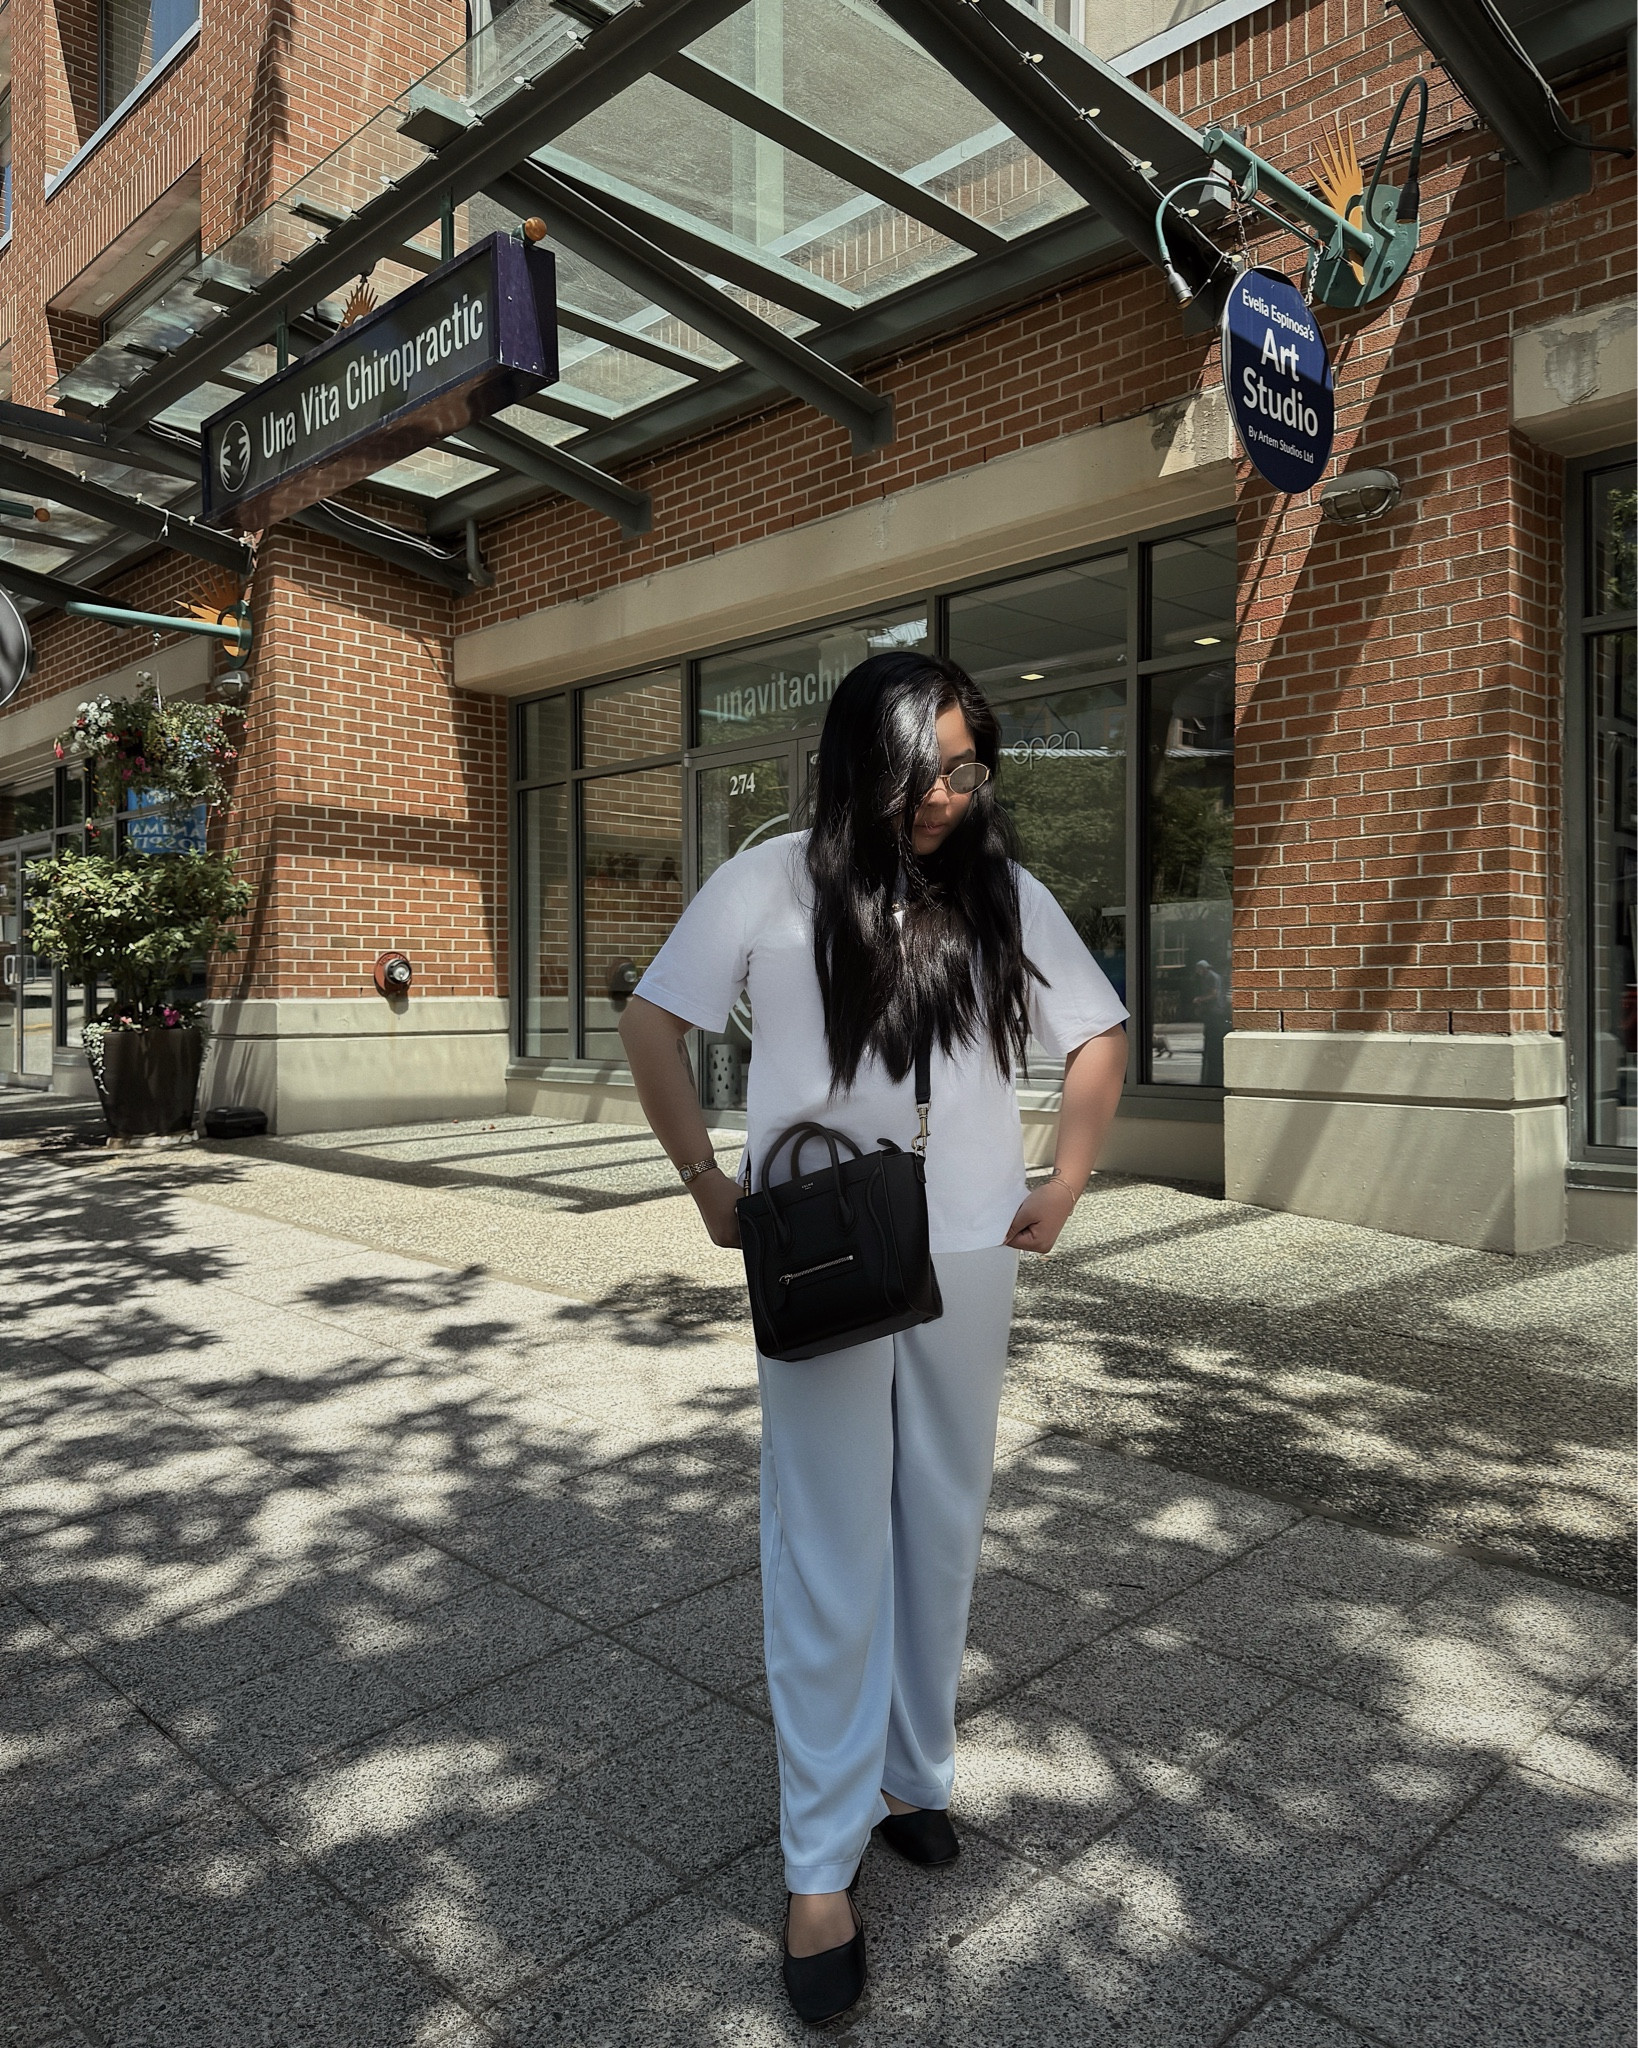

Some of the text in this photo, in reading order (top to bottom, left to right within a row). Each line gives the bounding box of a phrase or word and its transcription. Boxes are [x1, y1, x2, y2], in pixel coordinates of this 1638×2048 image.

[1242, 288, 1315, 342] Evelia Espinosa's
[262, 294, 484, 459] Una Vita Chiropractic
[1261, 327, 1300, 382] Art
[1243, 366, 1319, 437] Studio
[1248, 424, 1314, 464] By Artem Studios Ltd
[1012, 730, 1081, 770] open
[729, 772, 756, 796] 274
